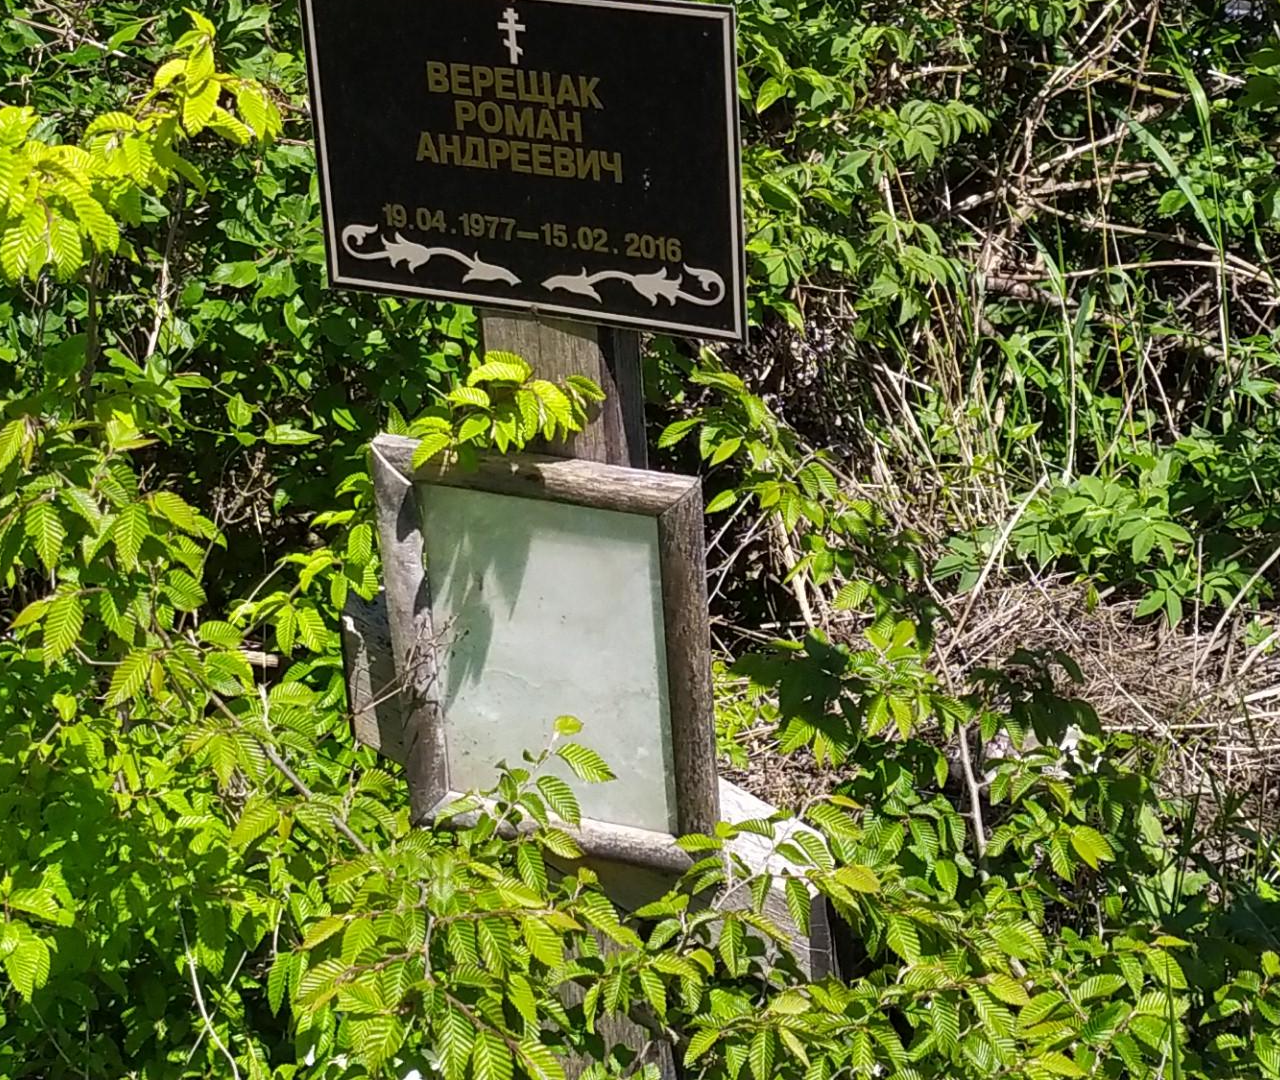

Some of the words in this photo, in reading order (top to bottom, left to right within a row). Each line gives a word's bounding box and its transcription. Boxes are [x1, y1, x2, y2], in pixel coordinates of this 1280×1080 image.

[426, 61, 604, 110] ВЕРЕЩАК
[454, 100, 583, 143] РОМАН
[416, 131, 623, 183] АНДРЕЕВИЧ
